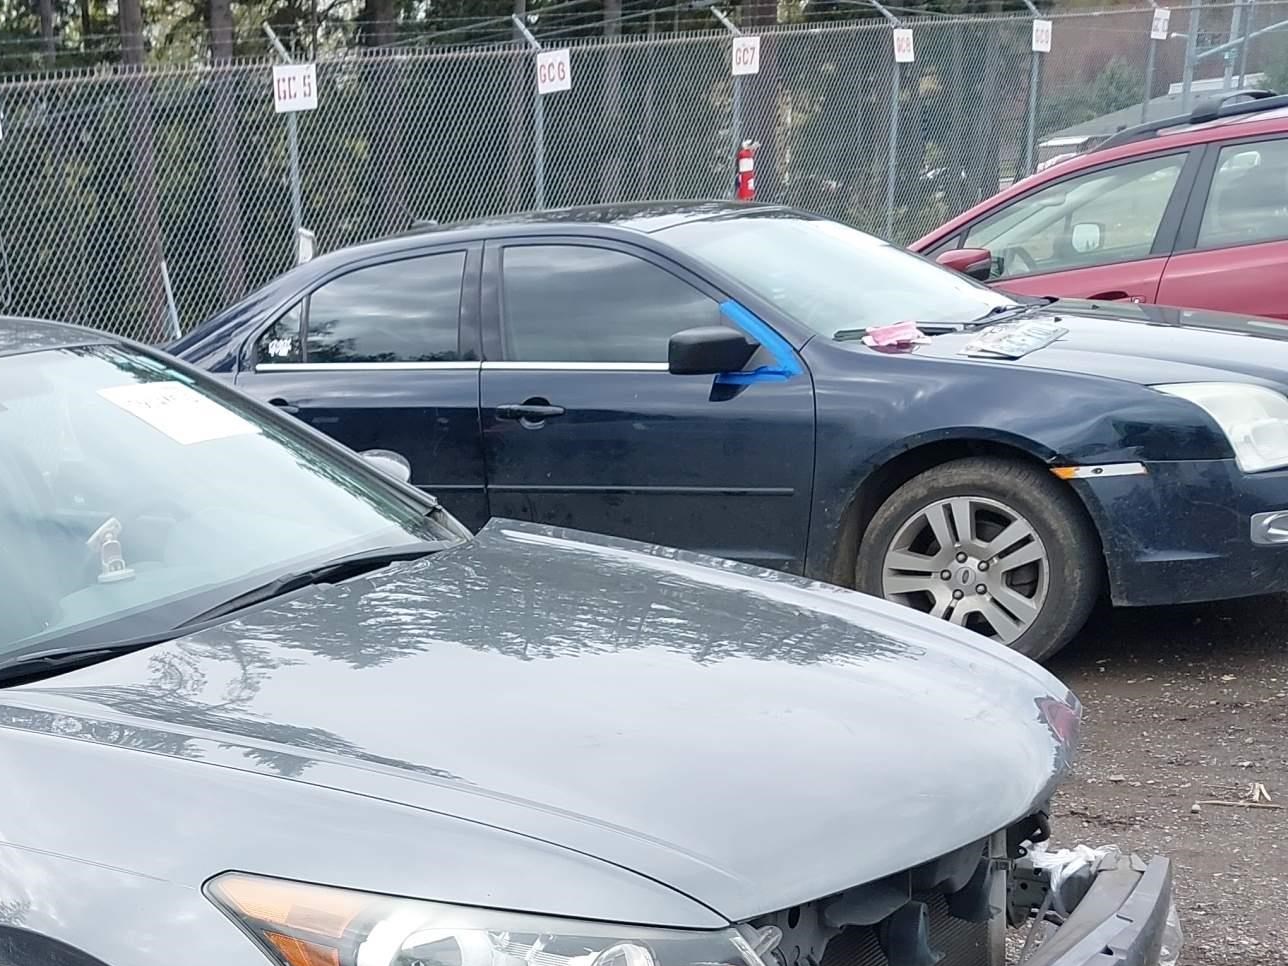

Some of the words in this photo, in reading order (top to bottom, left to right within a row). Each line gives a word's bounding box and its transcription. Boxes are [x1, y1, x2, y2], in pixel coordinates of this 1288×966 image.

[735, 47, 756, 65] GC7
[539, 61, 566, 84] GC6
[276, 75, 297, 101] GC
[302, 74, 312, 97] 5
